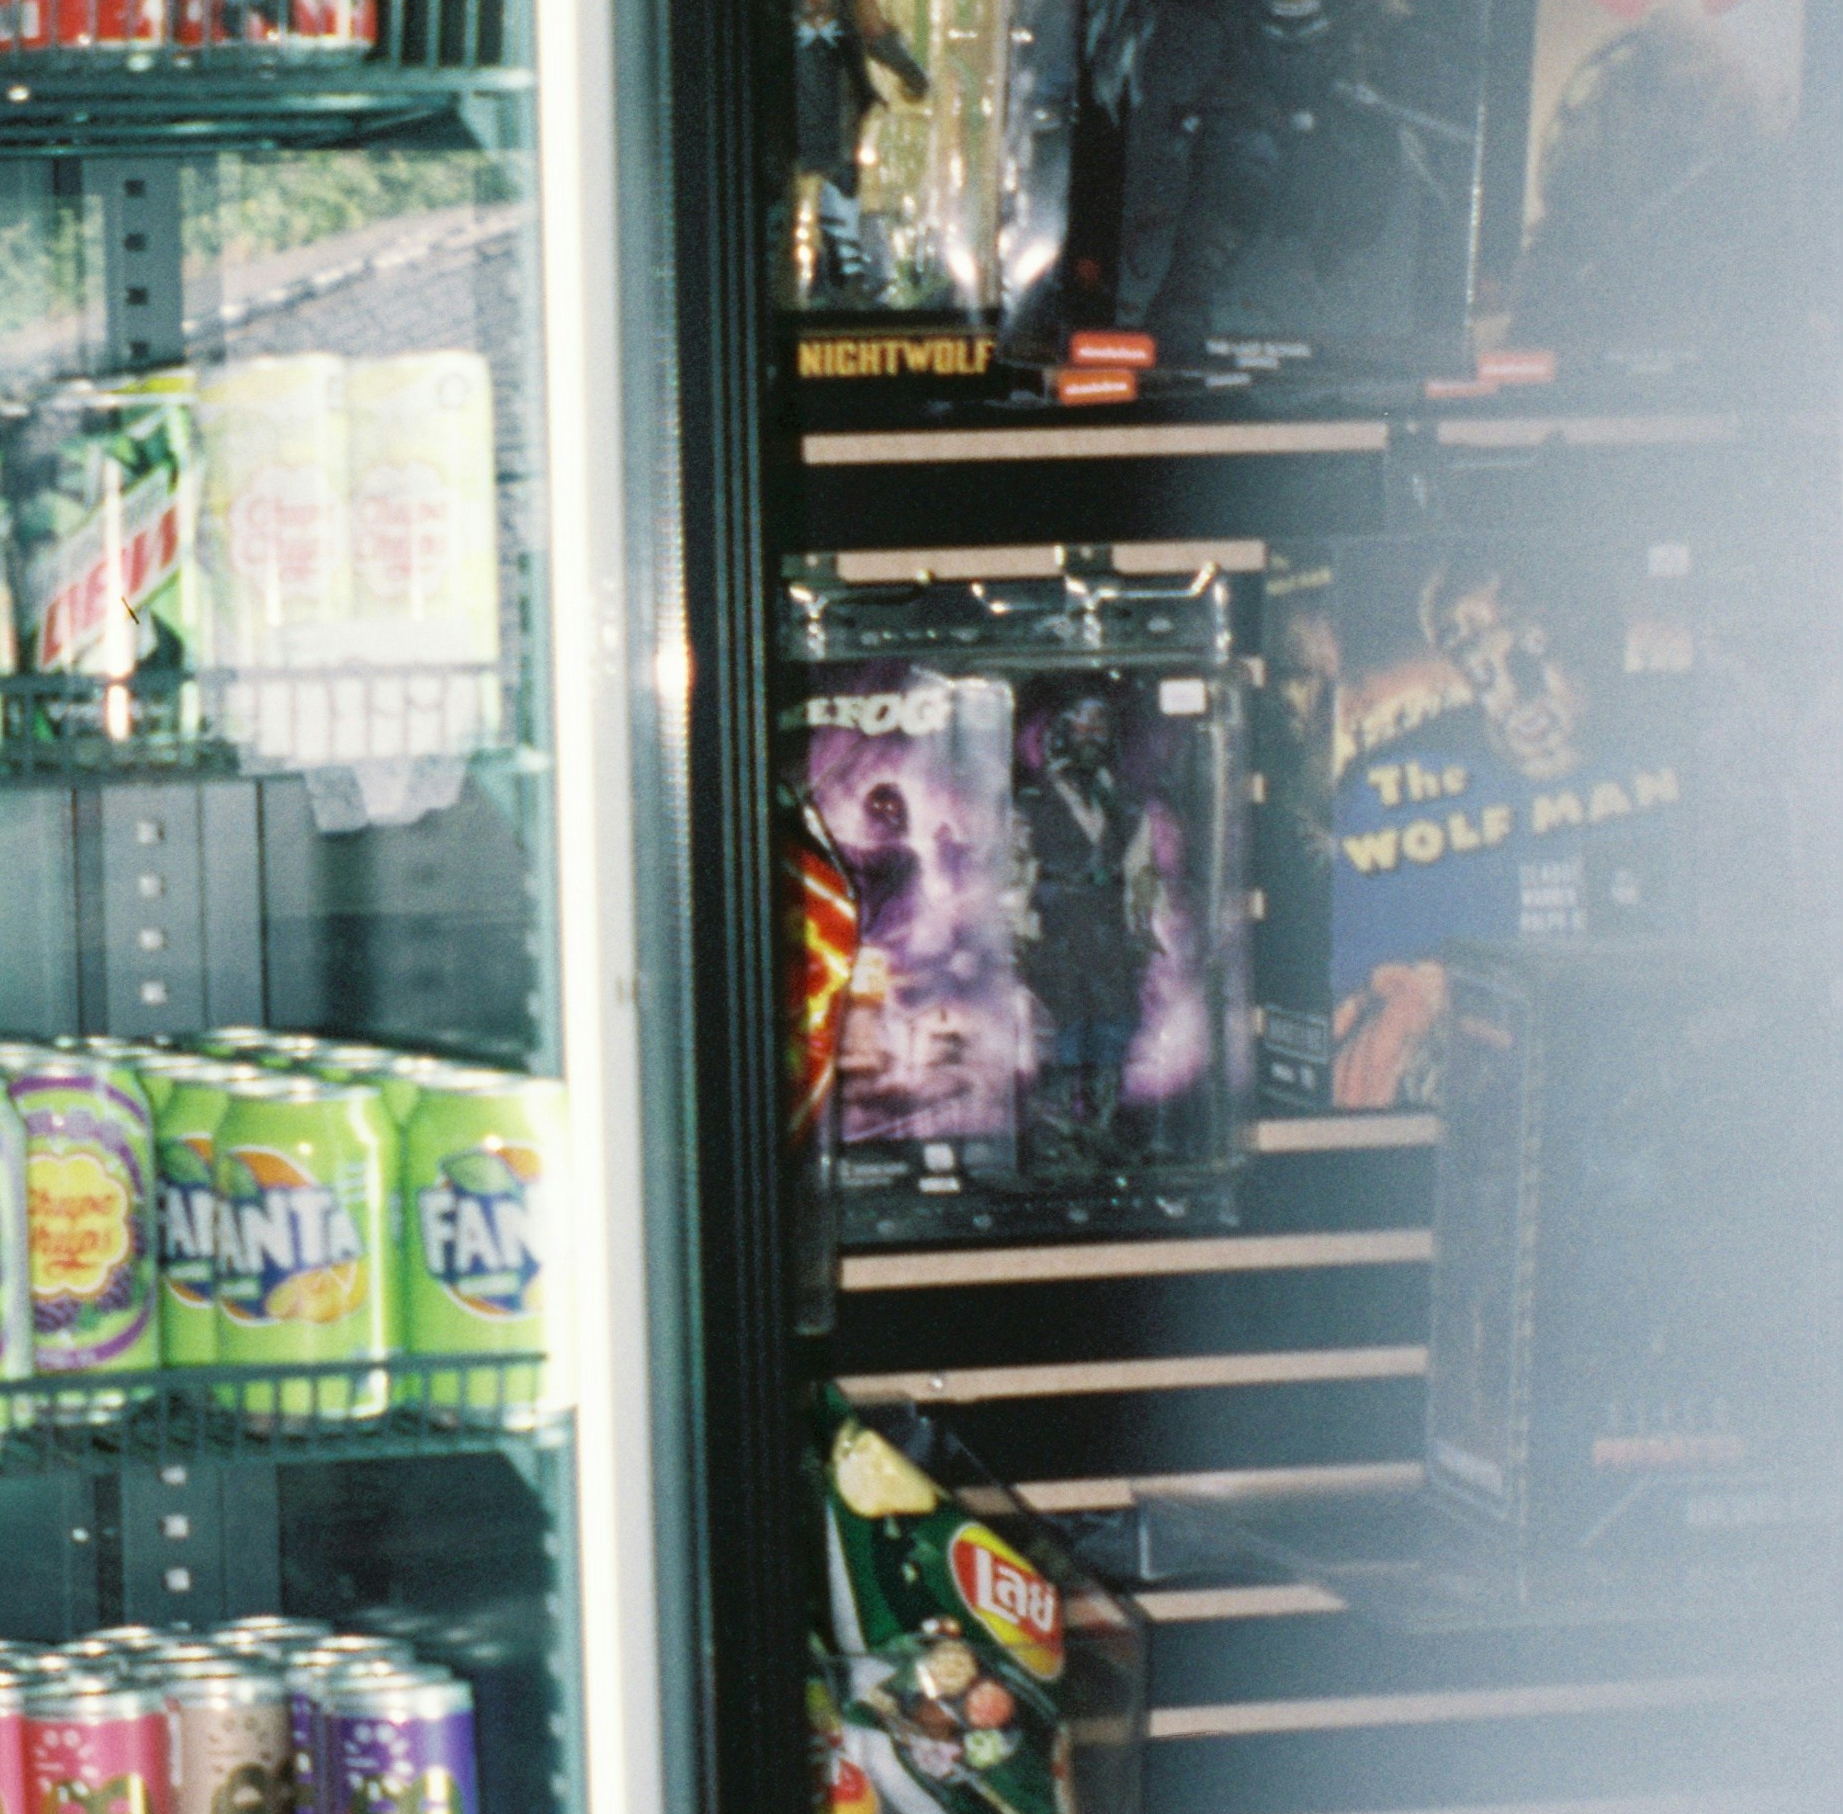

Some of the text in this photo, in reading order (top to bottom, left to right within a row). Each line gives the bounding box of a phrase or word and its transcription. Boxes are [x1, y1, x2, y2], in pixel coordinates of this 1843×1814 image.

[797, 335, 996, 378] NIGHTWOLF
[1367, 758, 1469, 810] The
[1341, 766, 1681, 875] WOLF MAN
[29, 1190, 115, 1218] hupa
[214, 1185, 358, 1274] ANTA
[421, 1187, 543, 1270] FAN
